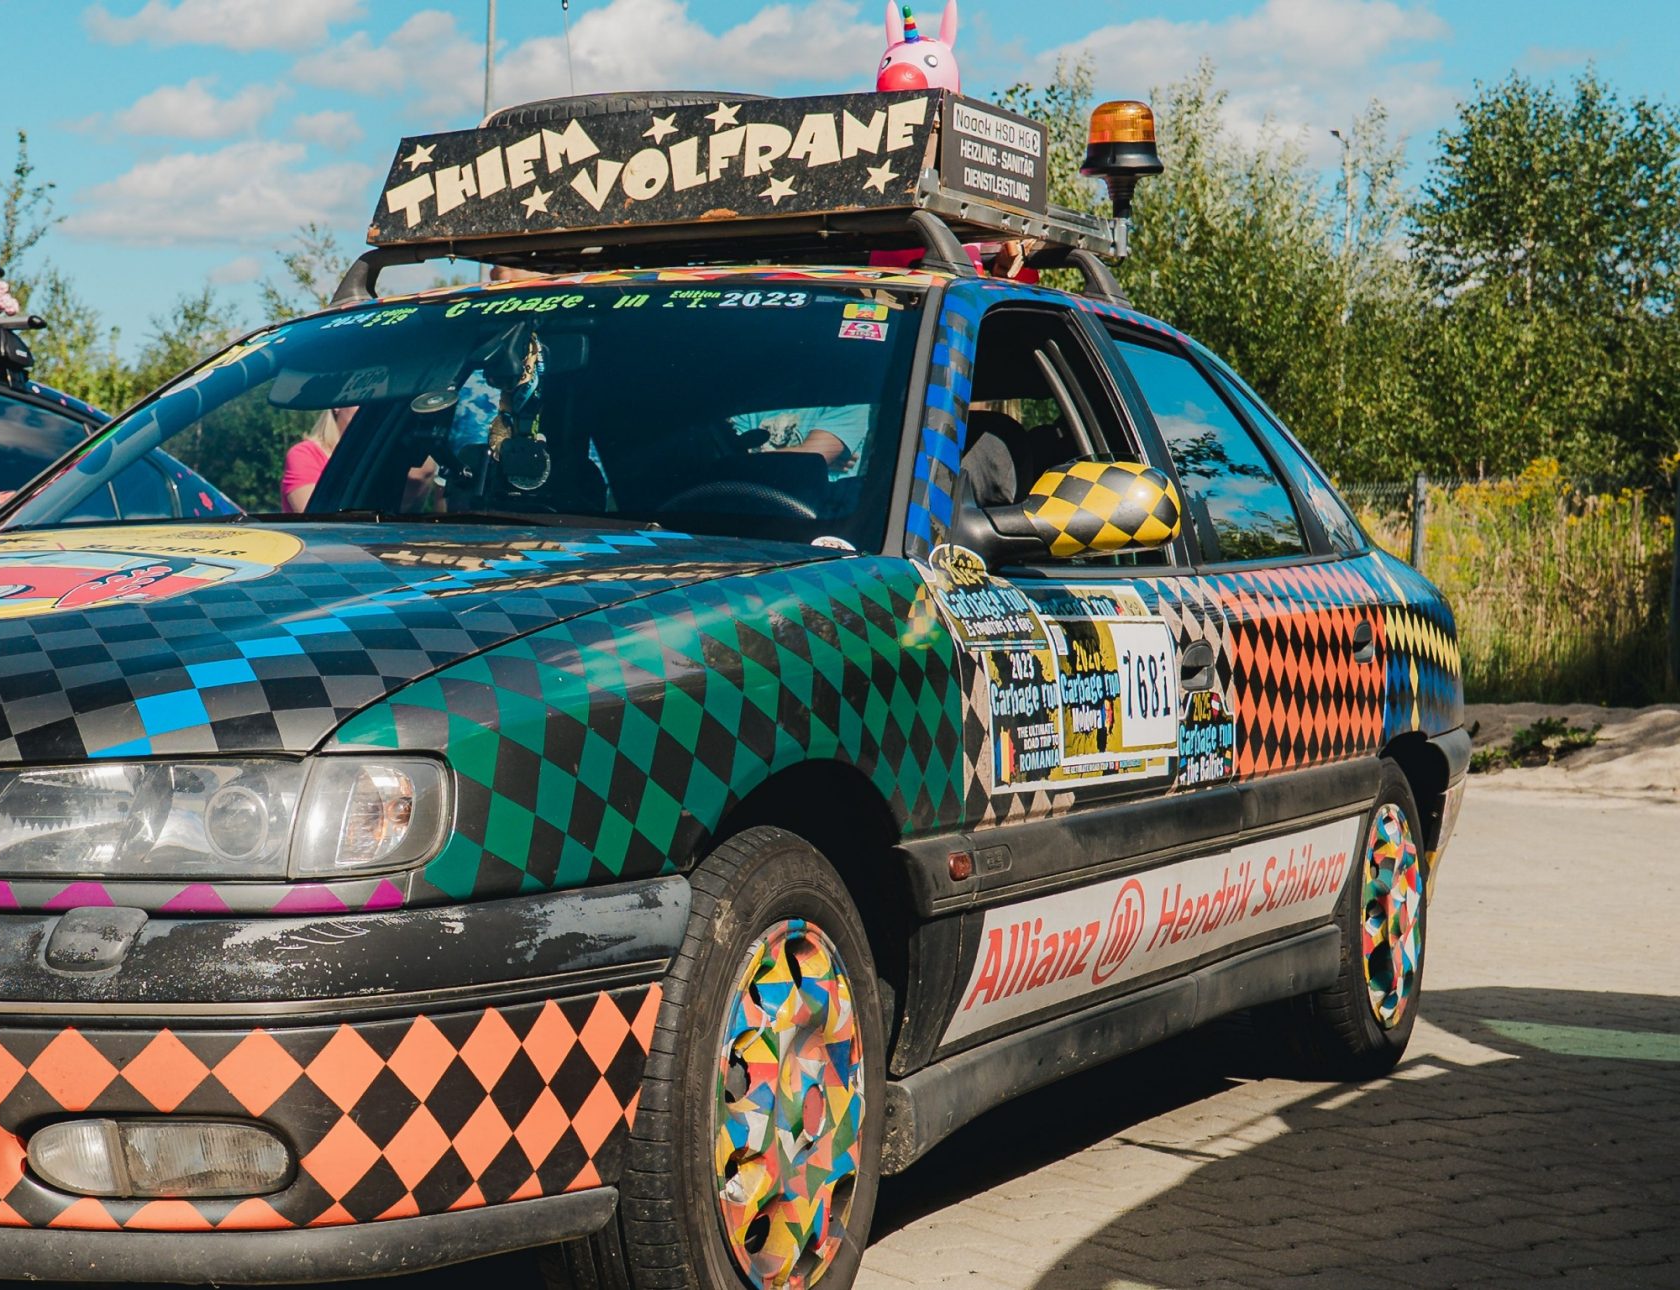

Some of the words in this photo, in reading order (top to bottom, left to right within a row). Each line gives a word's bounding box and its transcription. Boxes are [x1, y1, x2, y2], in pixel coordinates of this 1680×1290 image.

[386, 118, 600, 228] THIEM
[570, 97, 929, 212] VOLFRANE
[964, 167, 1030, 202] DIENSTLEISTUNG
[1010, 652, 1035, 680] 2023
[990, 683, 1041, 717] Carbage
[1060, 672, 1104, 705] Carbage
[1104, 672, 1121, 696] run
[1123, 650, 1171, 719] 7681
[1180, 723, 1217, 756] Carbage
[1219, 723, 1232, 748] run
[1020, 748, 1060, 772] ROMANIA
[964, 917, 1101, 1011] Allianz
[1146, 861, 1256, 952] Hendrik
[1251, 844, 1346, 918] Schikora
